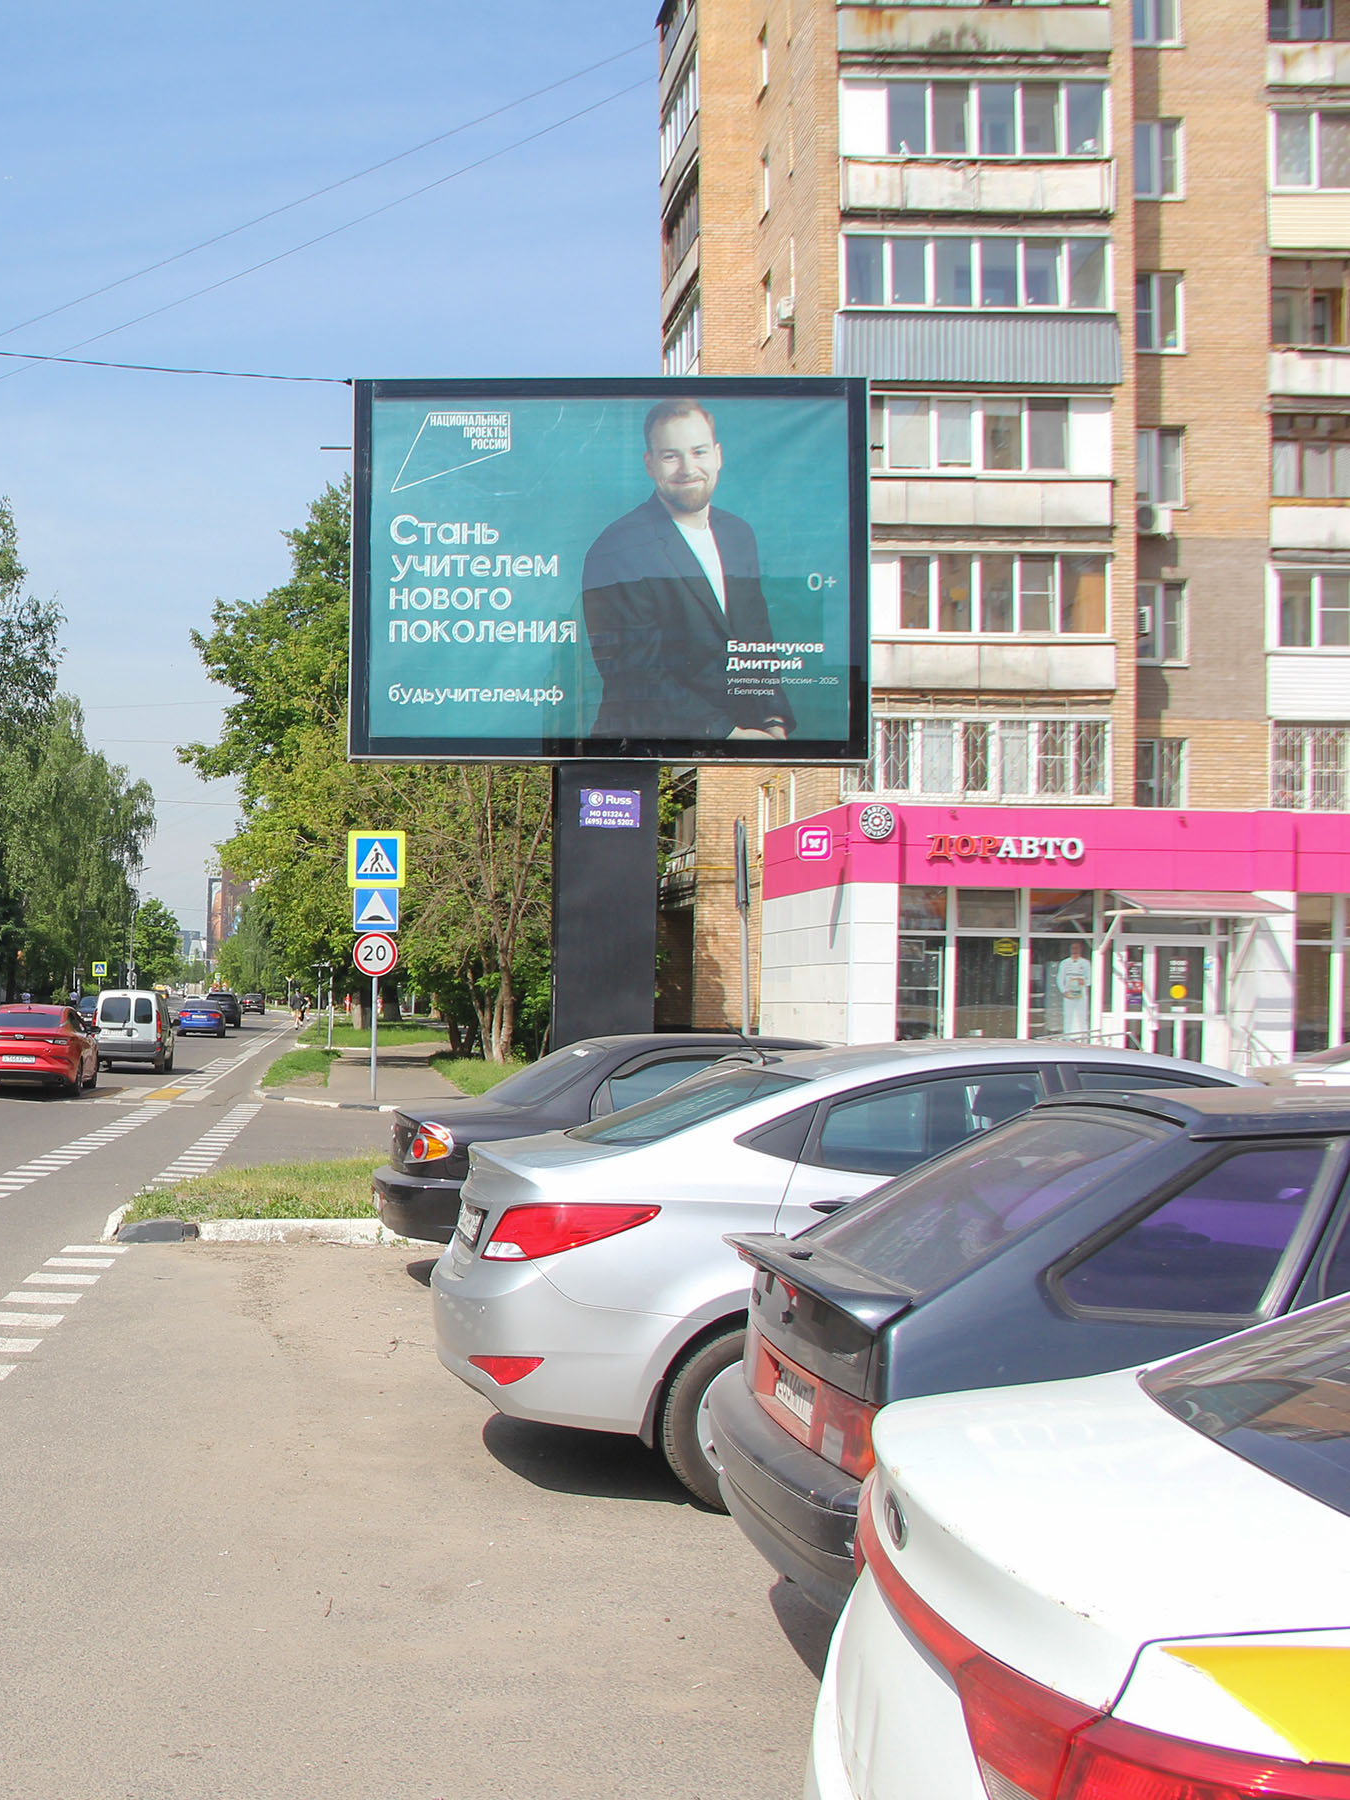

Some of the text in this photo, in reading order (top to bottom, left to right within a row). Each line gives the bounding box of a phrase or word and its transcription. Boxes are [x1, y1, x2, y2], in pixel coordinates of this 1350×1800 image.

[430, 414, 508, 427] НАЦИОНАЛЬНЫЕ
[462, 426, 508, 438] ПРОЕКТЫ
[471, 438, 508, 450] РОССИИ
[389, 514, 500, 545] Стань
[389, 554, 560, 583] учителем
[807, 572, 837, 592] 0+
[389, 587, 513, 611] нового
[388, 619, 577, 643] поколения
[726, 640, 825, 655] Баланчуков
[726, 657, 803, 672] Дмитрий
[726, 677, 761, 685] учитель
[761, 677, 781, 685] года
[781, 676, 811, 685] России
[388, 683, 564, 706] будьучителем.рф
[734, 687, 775, 697] Белгород
[605, 794, 633, 805] Russ
[926, 834, 1085, 861] ДОРАВТО
[363, 945, 387, 961] 20
